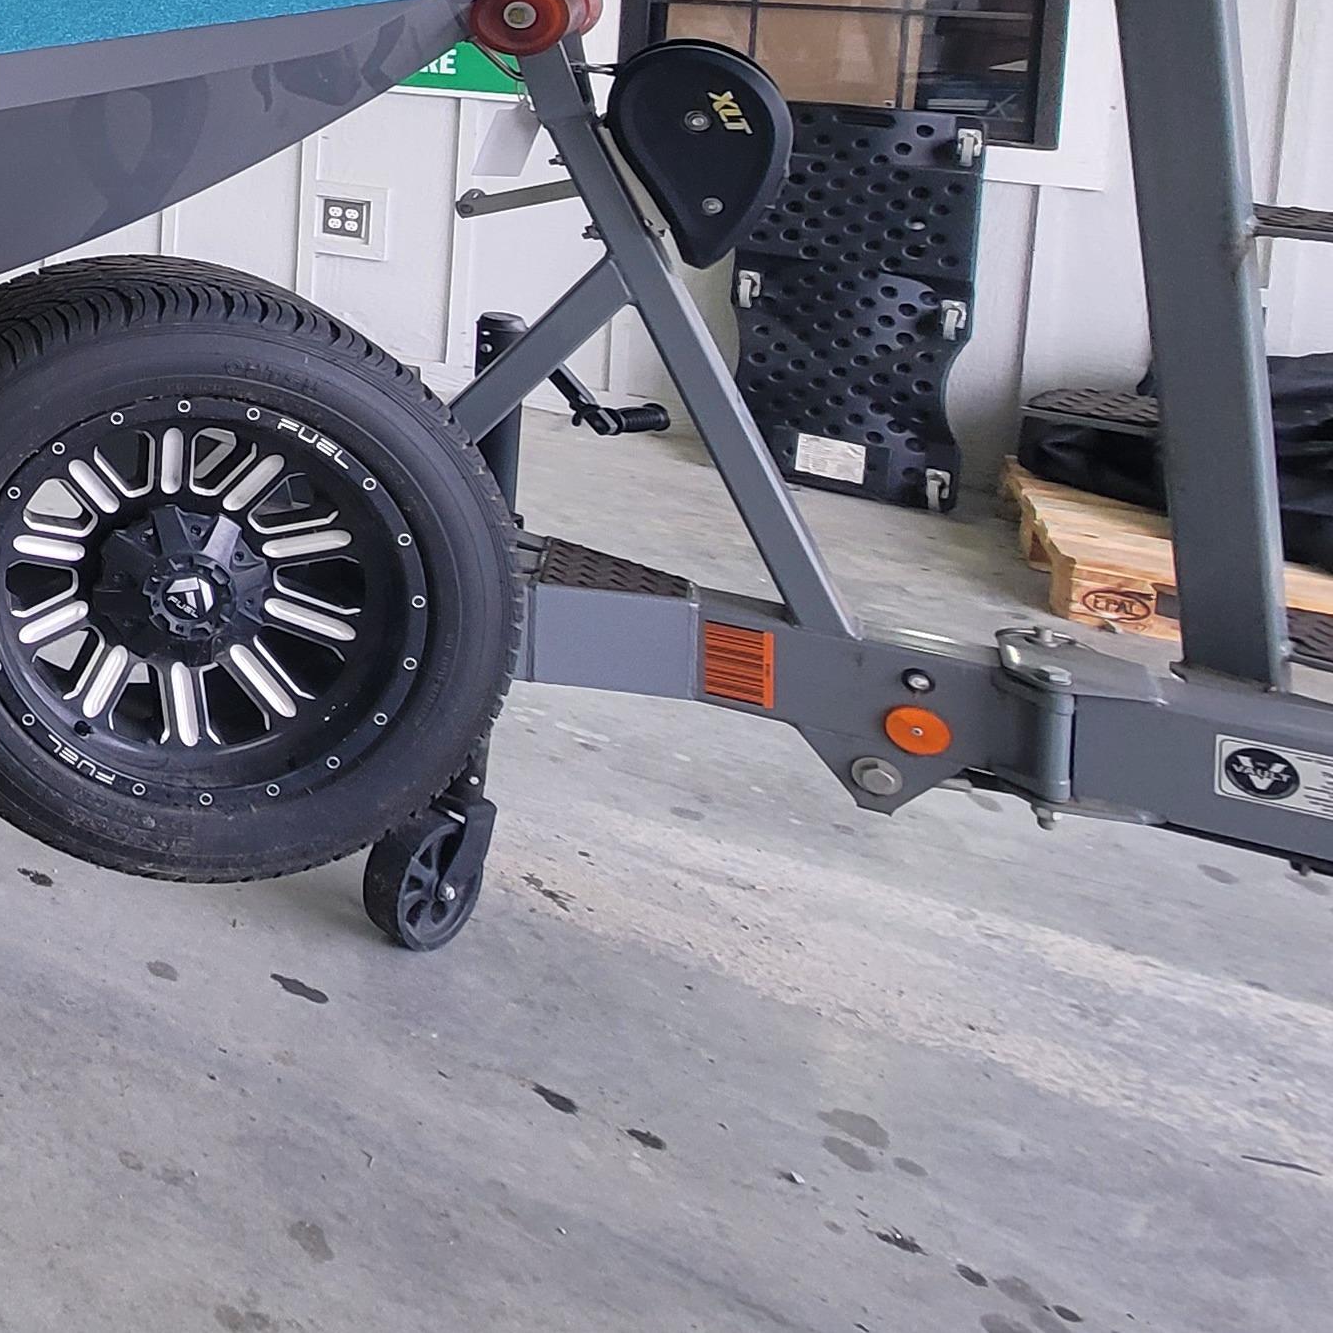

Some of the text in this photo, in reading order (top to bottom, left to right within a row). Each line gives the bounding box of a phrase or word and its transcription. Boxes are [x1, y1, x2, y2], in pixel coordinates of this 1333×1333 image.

[707, 90, 753, 135] XLT
[276, 417, 349, 470] FUEL
[166, 595, 199, 619] FUEL
[48, 733, 116, 785] FUEL
